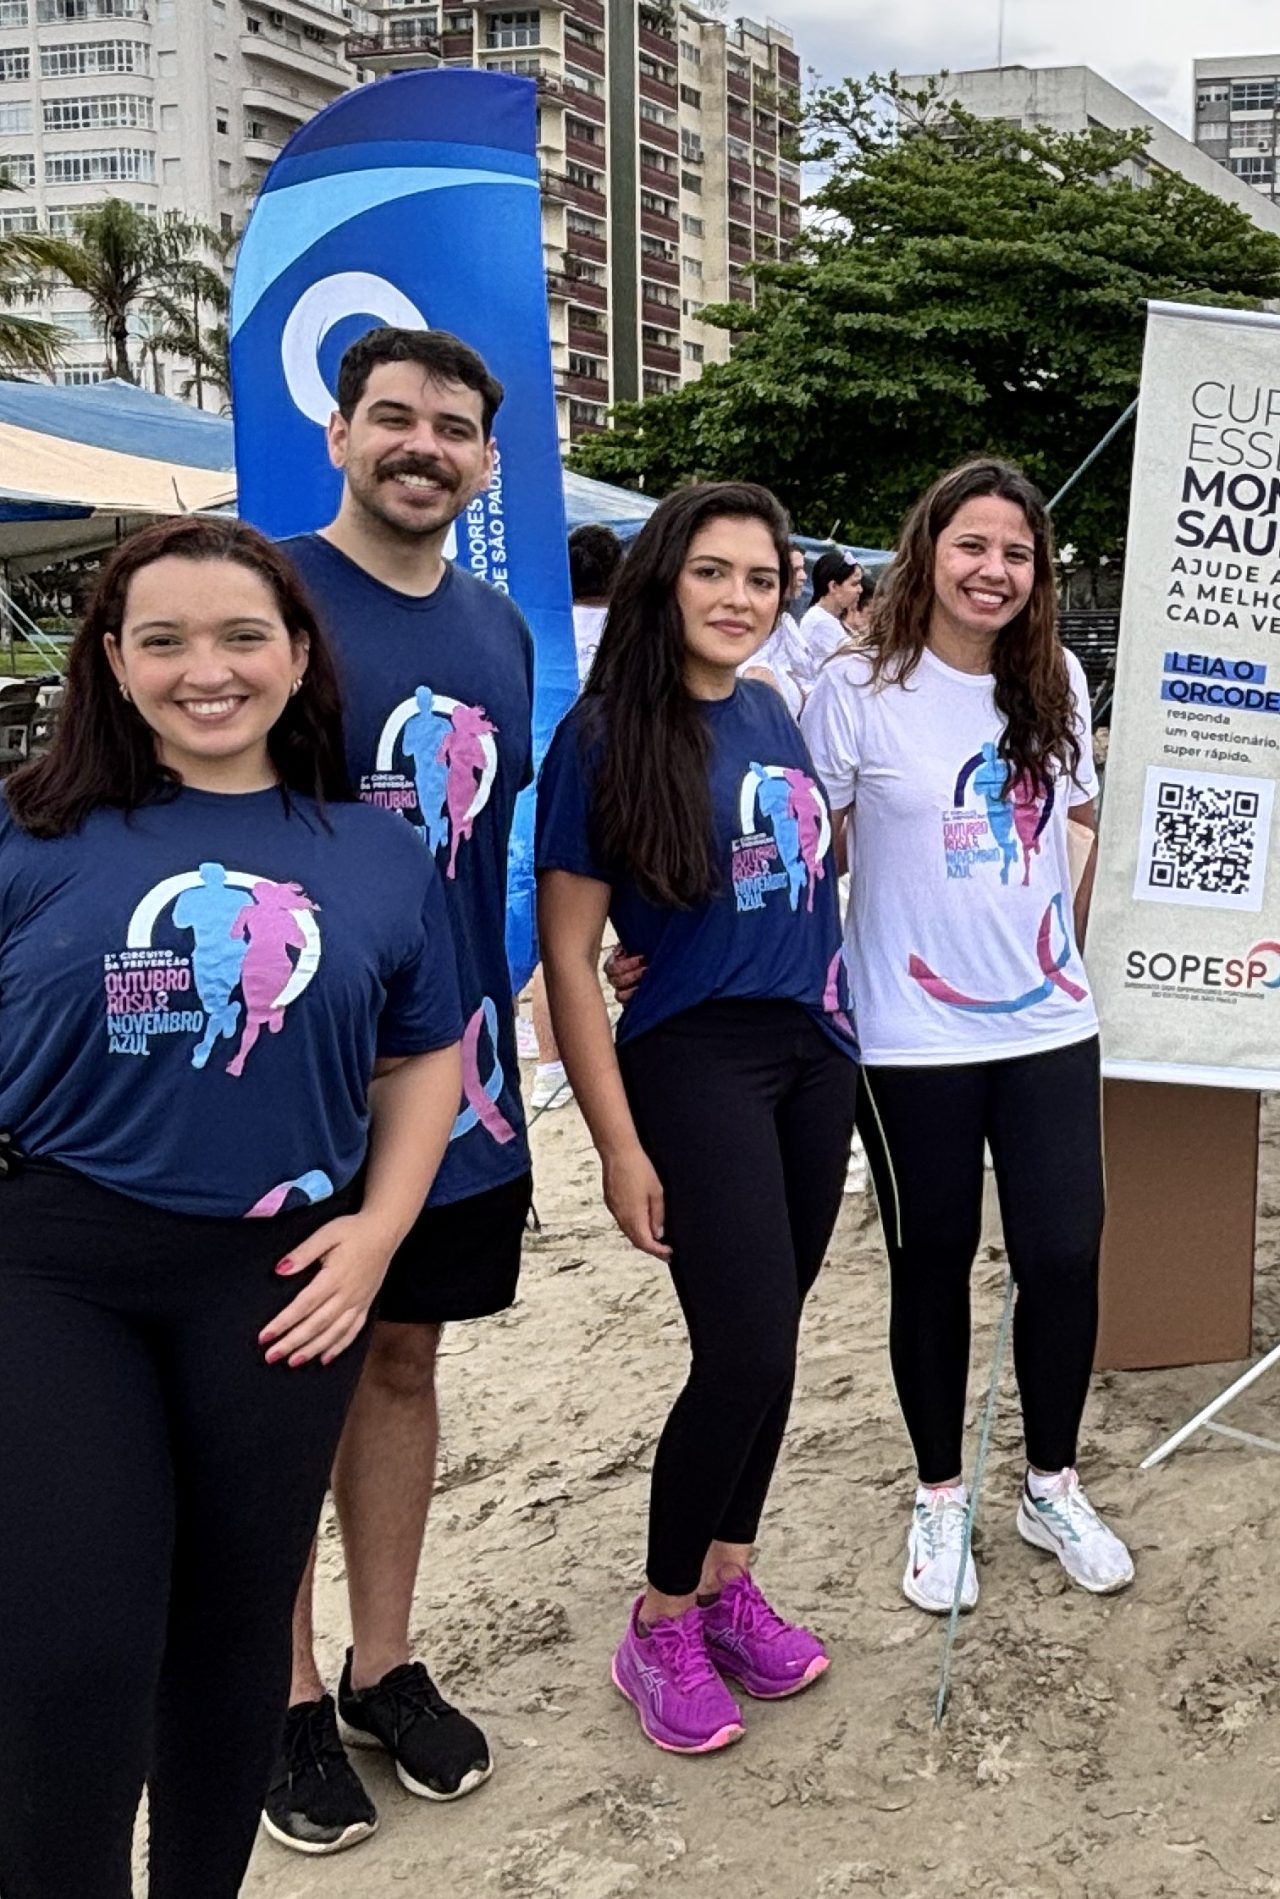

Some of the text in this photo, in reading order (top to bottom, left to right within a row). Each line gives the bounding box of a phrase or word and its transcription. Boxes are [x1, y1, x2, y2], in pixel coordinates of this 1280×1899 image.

[488, 519, 508, 563] SÃO
[1170, 556, 1261, 584] AJUDE
[1167, 580, 1185, 598] A
[1166, 603, 1240, 630] CADA
[1171, 651, 1255, 681] LEIA O
[1166, 708, 1231, 725] responda
[1163, 743, 1202, 758] super
[1164, 726, 1280, 751] um questionário,
[120, 949, 174, 961] CIRCUITO
[104, 967, 191, 994] OUTUBRO
[1126, 950, 1268, 989] SOPESP
[106, 992, 153, 1015] ROSA
[107, 1010, 204, 1036] NOVEMBRO
[108, 1033, 151, 1056] AZUL
